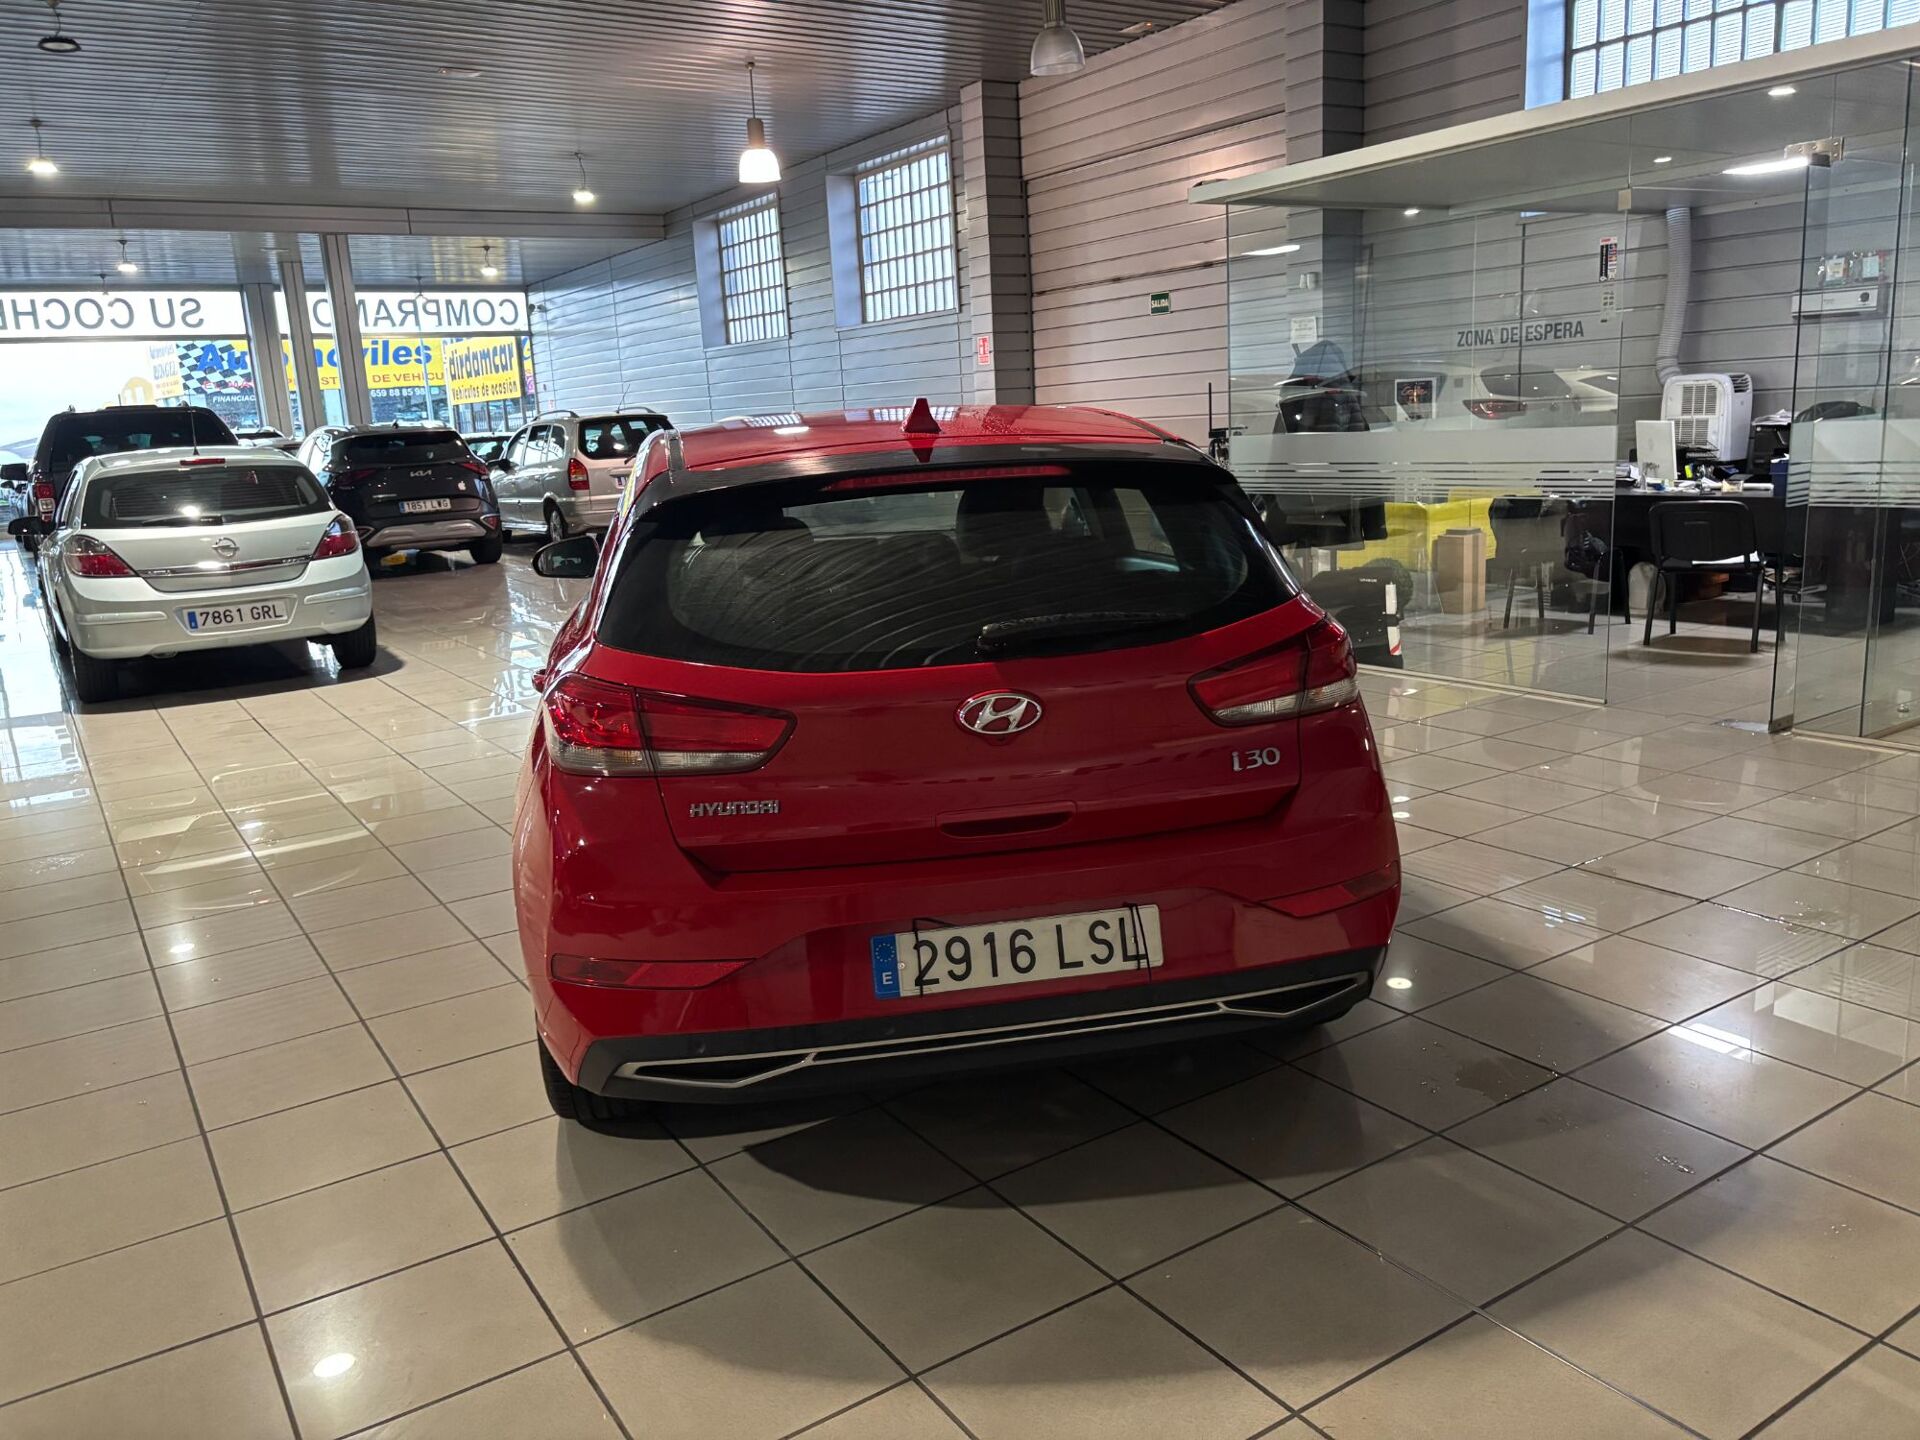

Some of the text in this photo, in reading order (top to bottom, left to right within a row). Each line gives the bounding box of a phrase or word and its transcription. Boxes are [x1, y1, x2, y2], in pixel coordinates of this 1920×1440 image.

[1457, 320, 1584, 347] ZONA DE ESPERA
[449, 342, 514, 381] dirdamcar
[372, 372, 444, 383] DE VEHICU
[212, 395, 256, 404] FINANCIAC
[481, 381, 489, 397] de
[200, 604, 283, 626] 7861 GRL
[1232, 747, 1281, 771] i30
[689, 799, 779, 817] HYUNDAI
[882, 917, 1147, 987] E 2916 LSL
